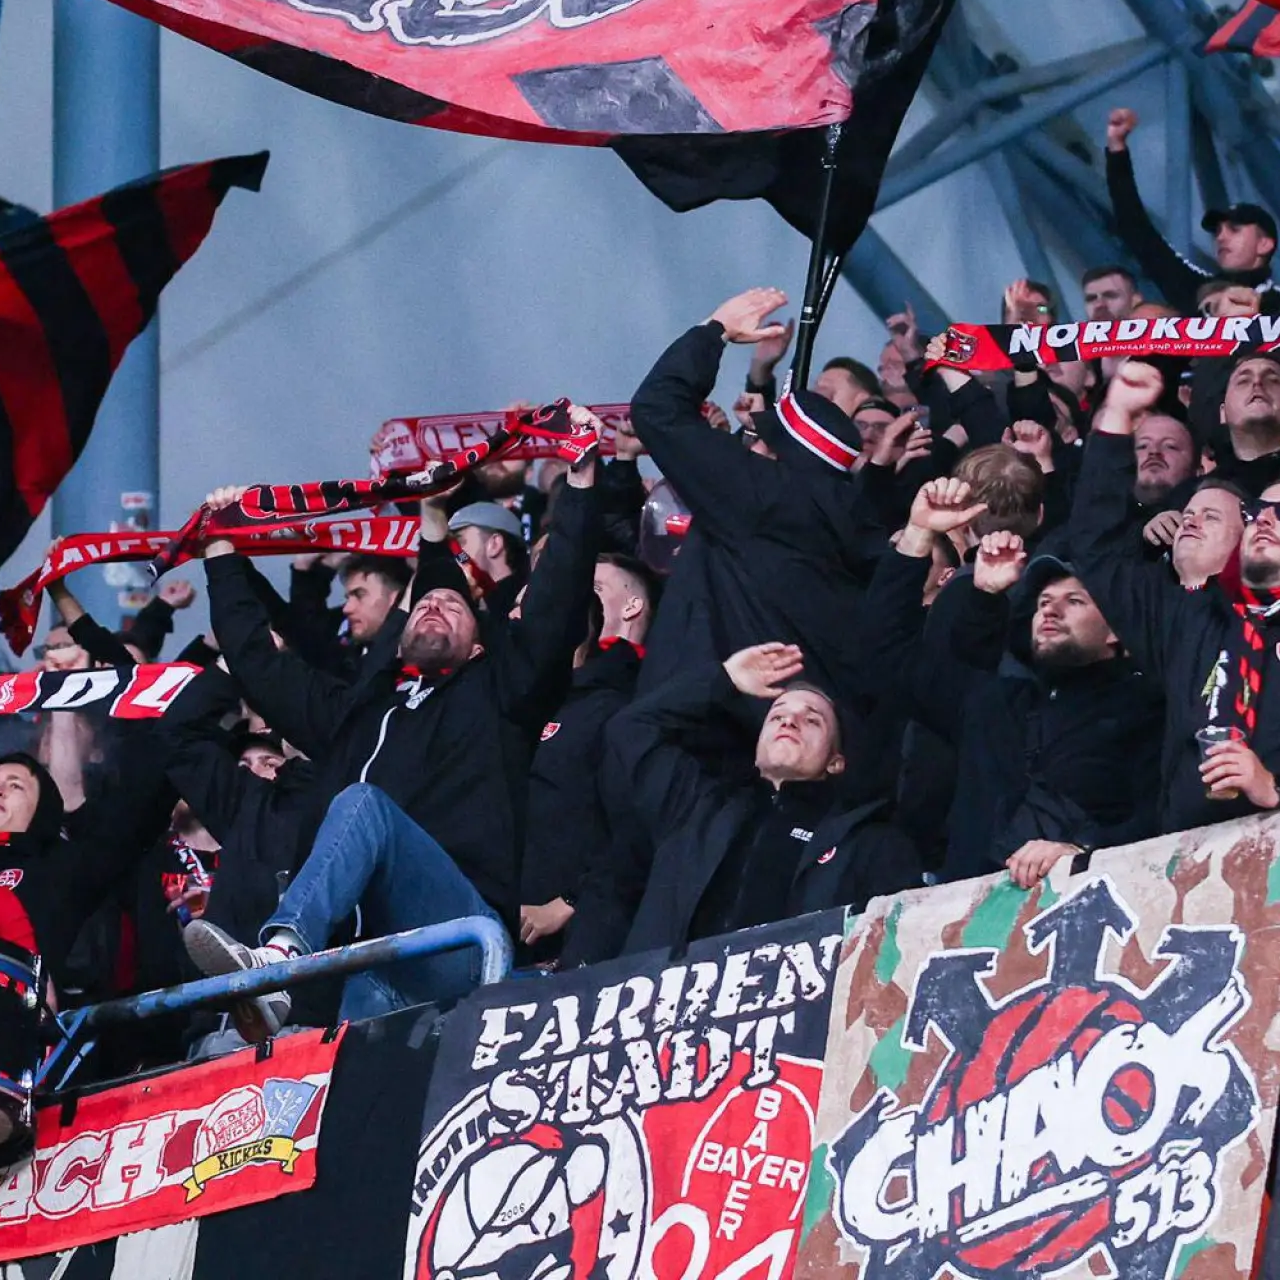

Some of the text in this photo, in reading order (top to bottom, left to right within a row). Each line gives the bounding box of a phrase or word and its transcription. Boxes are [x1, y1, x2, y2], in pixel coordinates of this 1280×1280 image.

[471, 933, 843, 1070] FARBEN
[487, 1014, 795, 1128] STADT
[499, 1203, 526, 1222] 2006
[696, 1141, 806, 1193] BAYER
[716, 1087, 782, 1242] BAYER
[1111, 1150, 1214, 1250] 513
